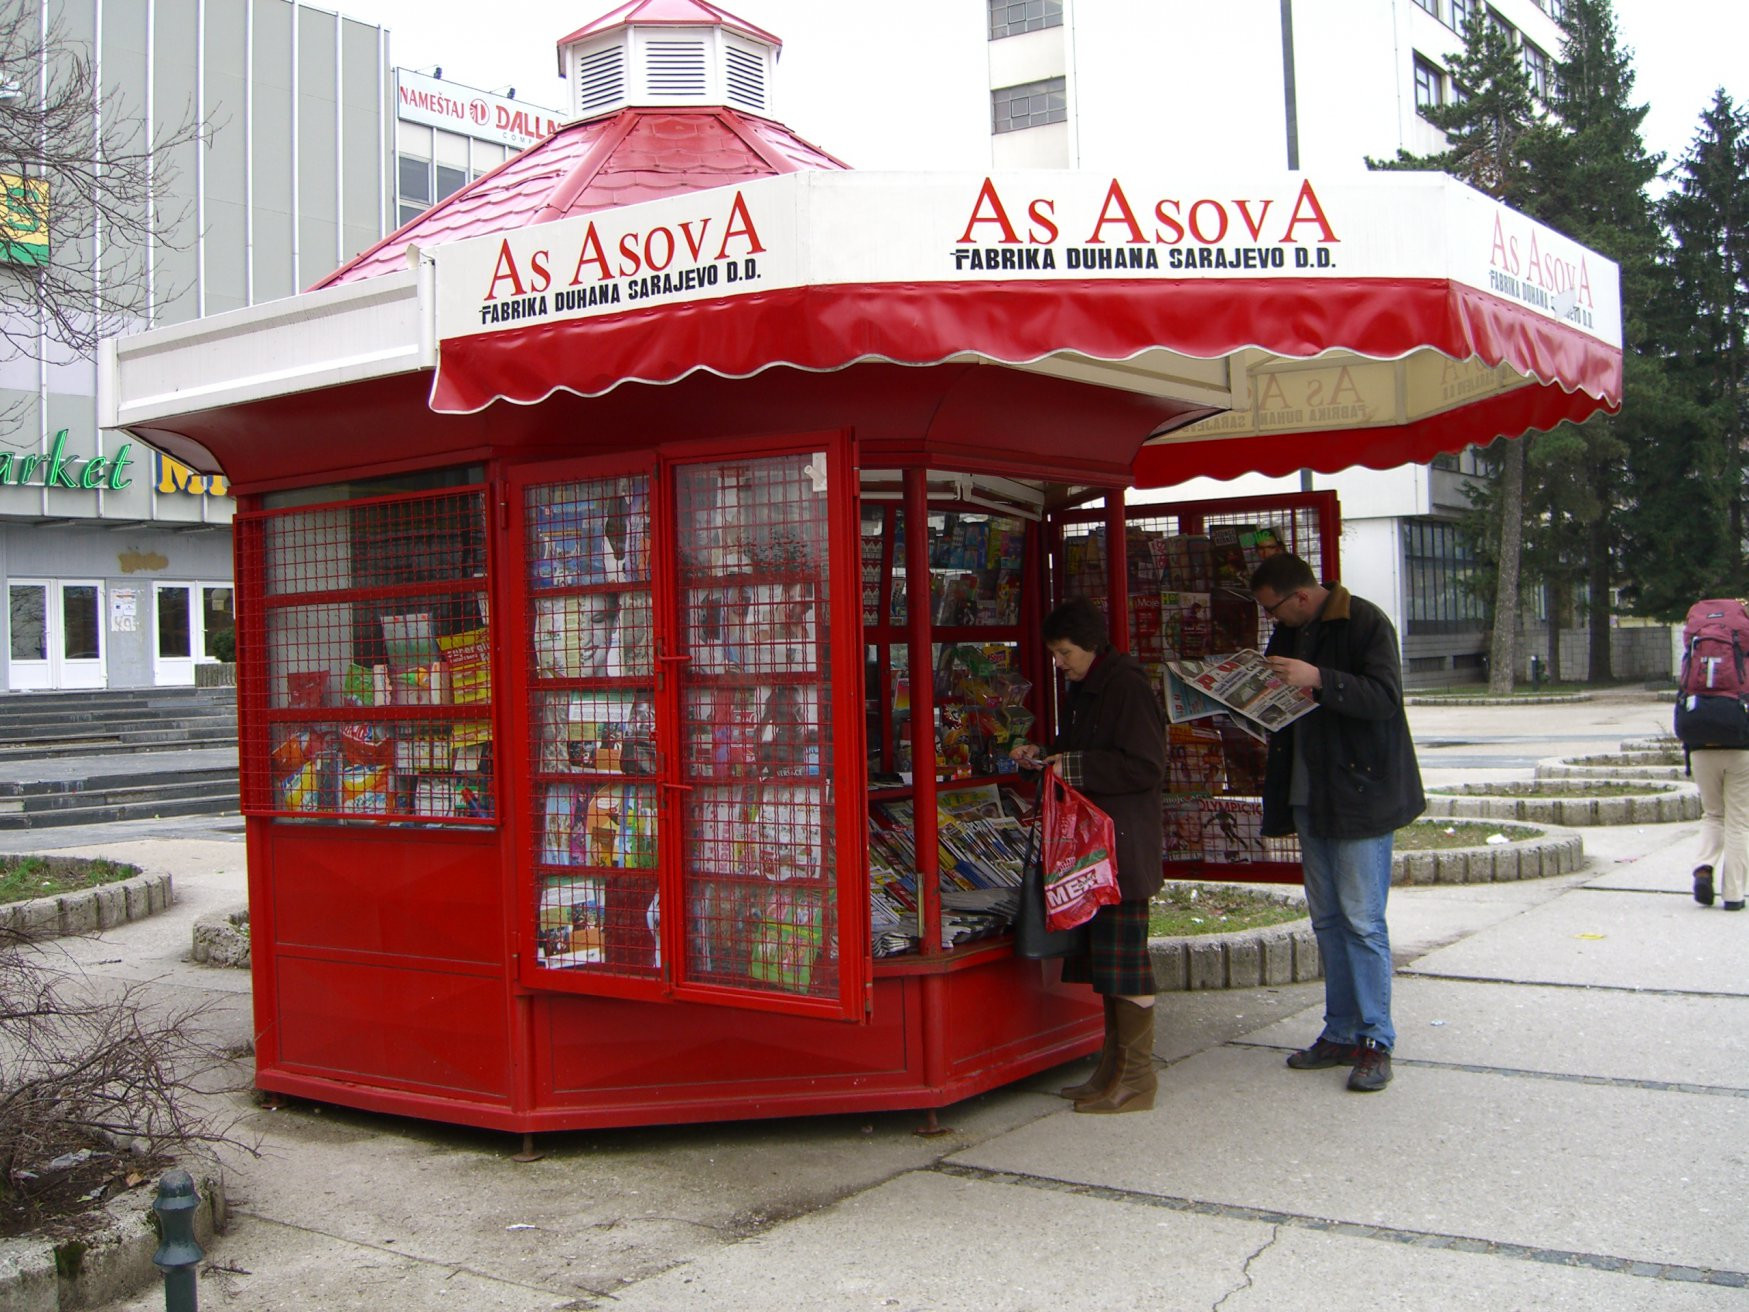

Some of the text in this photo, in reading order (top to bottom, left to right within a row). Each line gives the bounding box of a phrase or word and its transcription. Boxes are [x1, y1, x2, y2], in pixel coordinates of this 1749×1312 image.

[400, 85, 465, 119] NAMEŠTAJ
[951, 247, 1336, 270] FABRIKA DUHANA SARAJEVO D.D.
[480, 258, 762, 325] FABRIKA DUHANA SARAJEVO D.D.
[1489, 269, 1521, 300] FABRIKA
